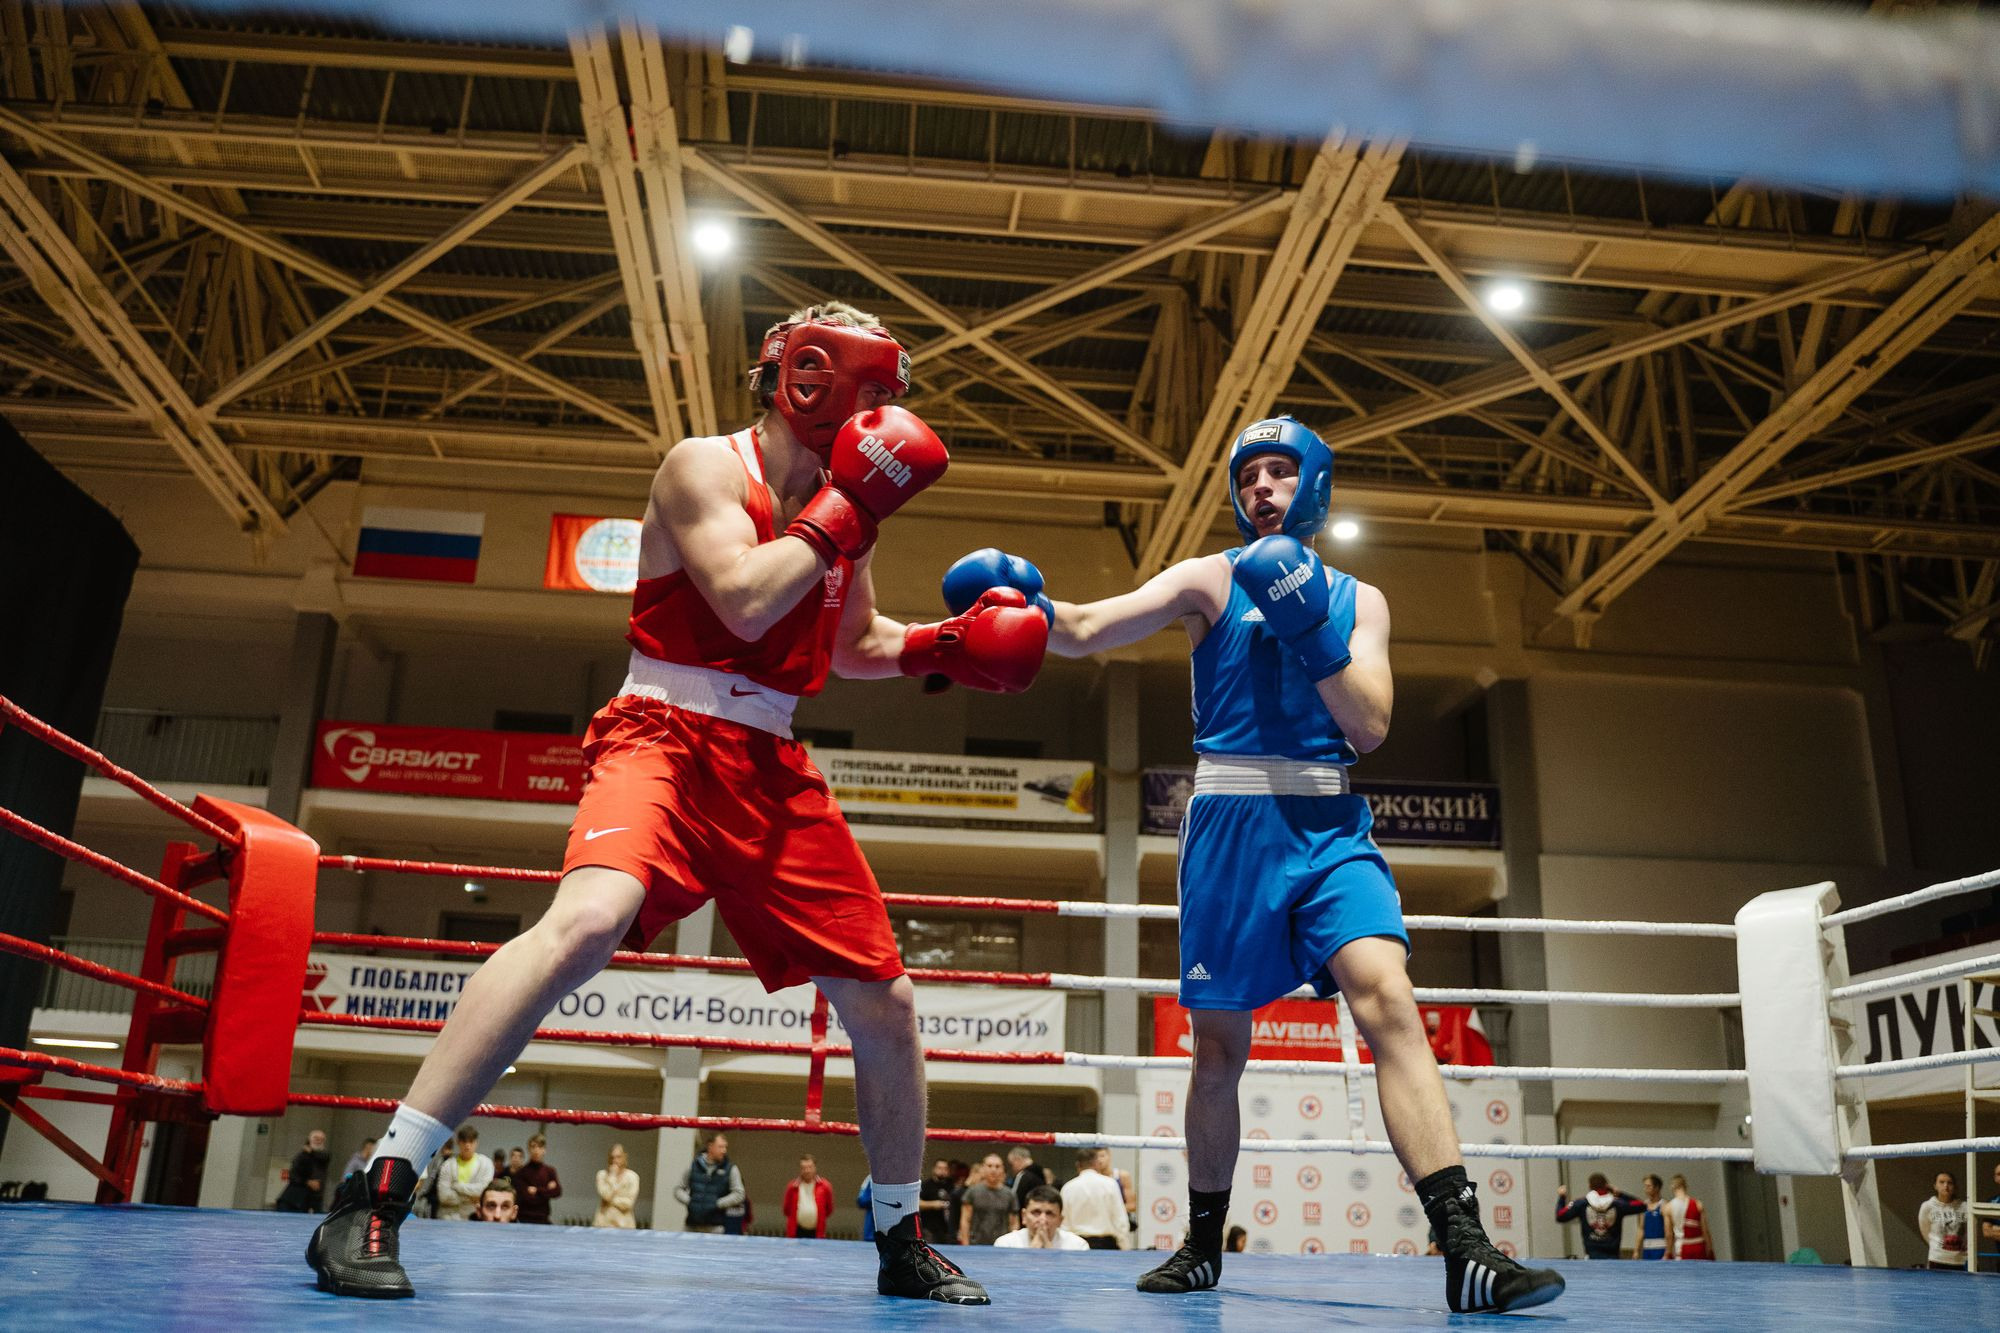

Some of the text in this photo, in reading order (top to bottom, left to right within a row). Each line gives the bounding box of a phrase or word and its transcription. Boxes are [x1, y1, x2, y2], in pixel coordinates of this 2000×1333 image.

[857, 435, 912, 488] clinch
[1267, 561, 1314, 604] clinch
[350, 745, 480, 771] СВЯЗИСТ
[1364, 793, 1488, 819] ЖСКИЙ
[1398, 819, 1466, 832] ЗАВОД
[548, 992, 605, 1017] ОО
[1864, 982, 2000, 1064] ЛУК
